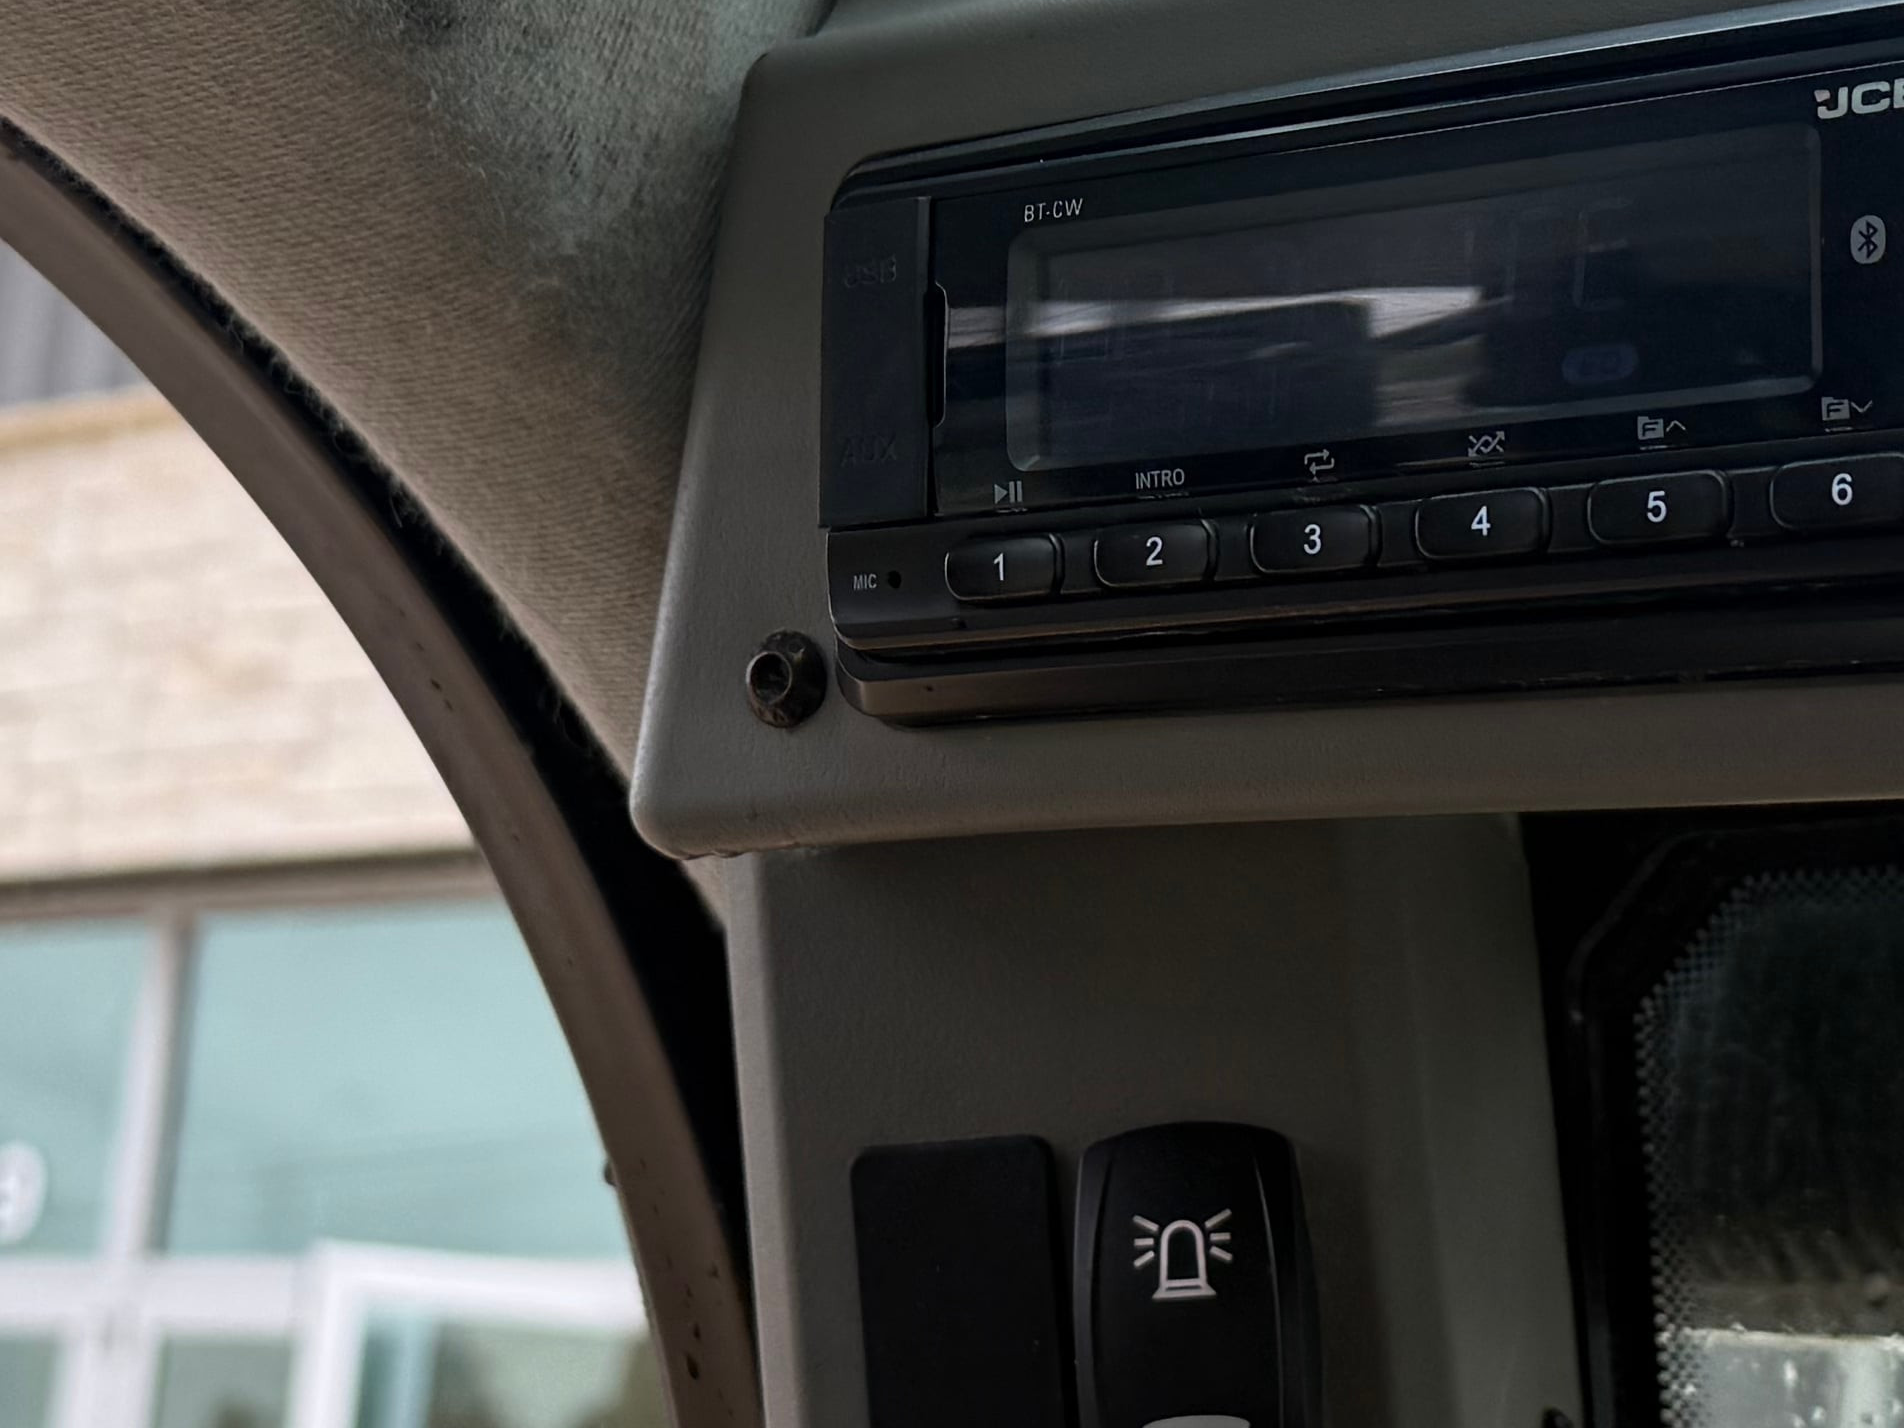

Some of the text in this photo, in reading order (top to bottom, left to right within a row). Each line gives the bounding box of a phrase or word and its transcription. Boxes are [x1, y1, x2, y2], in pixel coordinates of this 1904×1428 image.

[1135, 467, 1185, 490] INTRO
[1831, 473, 1853, 506] 6
[1470, 505, 1491, 537] 4
[1647, 490, 1667, 523] 5
[1146, 536, 1163, 567] 2
[1303, 523, 1322, 555] 3
[853, 573, 878, 590] MIC
[993, 552, 1005, 582] 1
